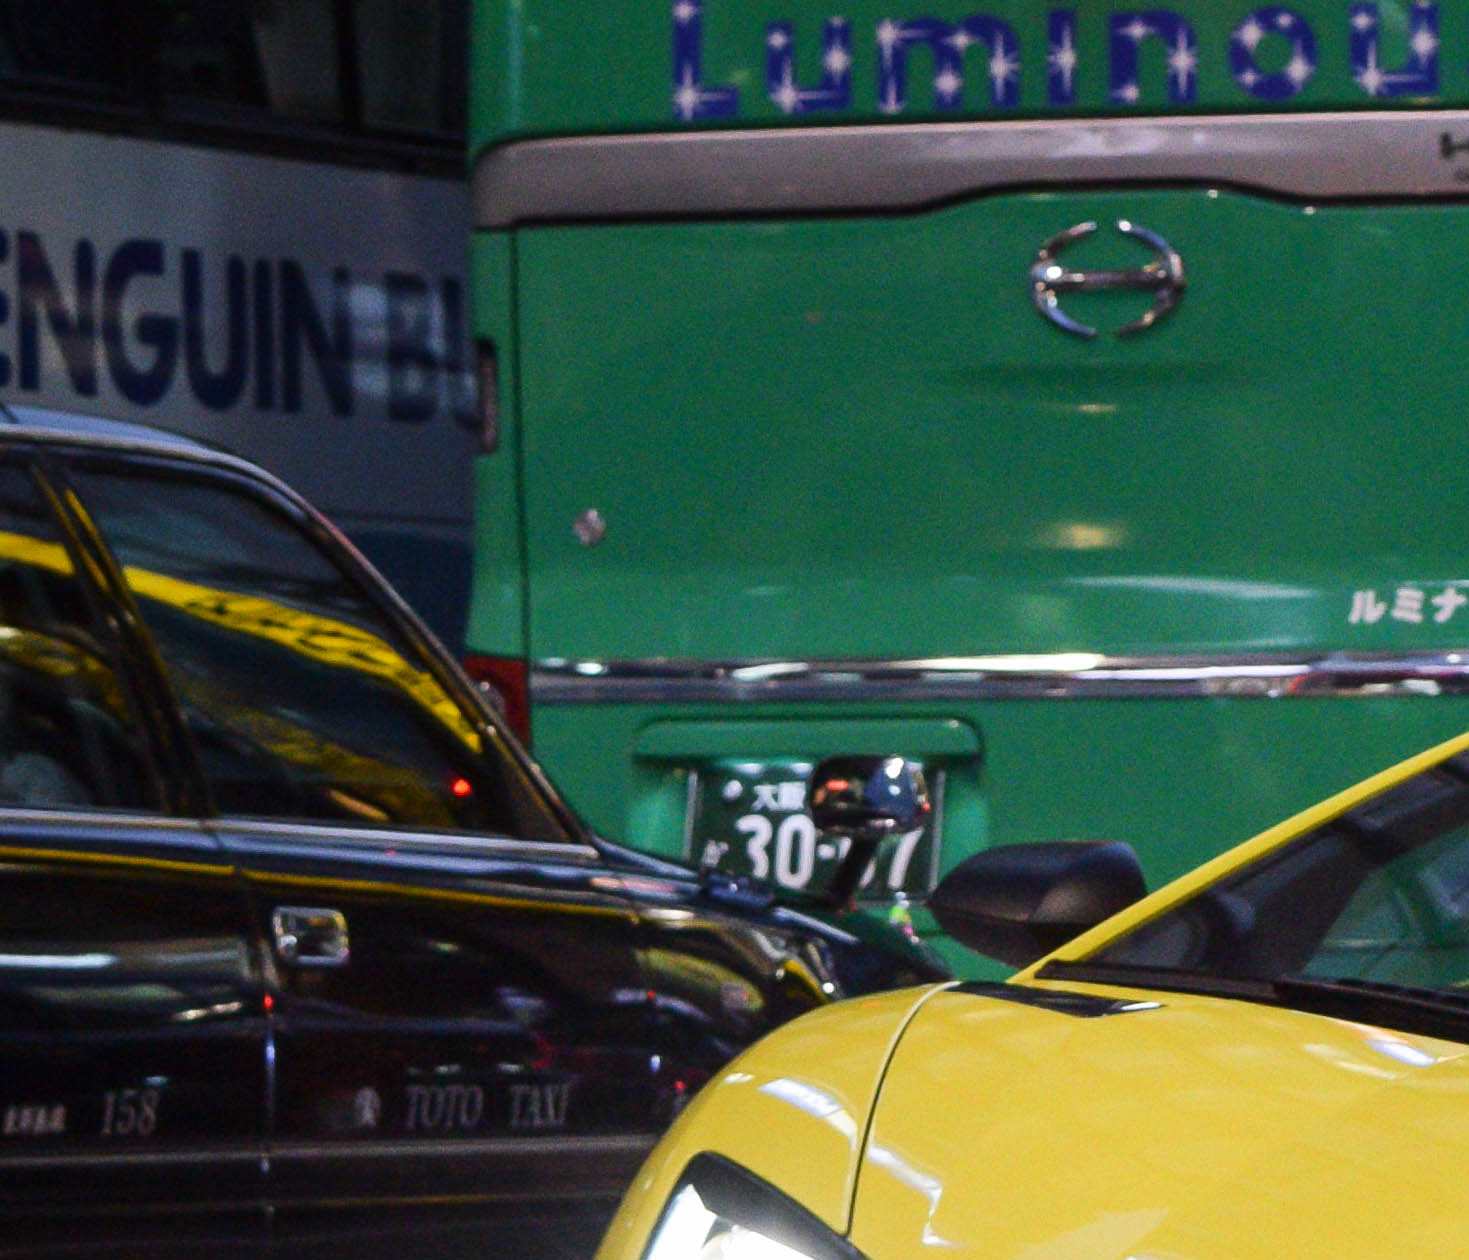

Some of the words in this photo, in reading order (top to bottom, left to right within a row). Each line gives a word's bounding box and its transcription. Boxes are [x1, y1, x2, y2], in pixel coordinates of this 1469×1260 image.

[102, 1088, 161, 1137] 158
[404, 1082, 485, 1130] TOTO
[509, 1082, 575, 1129] TAXI
